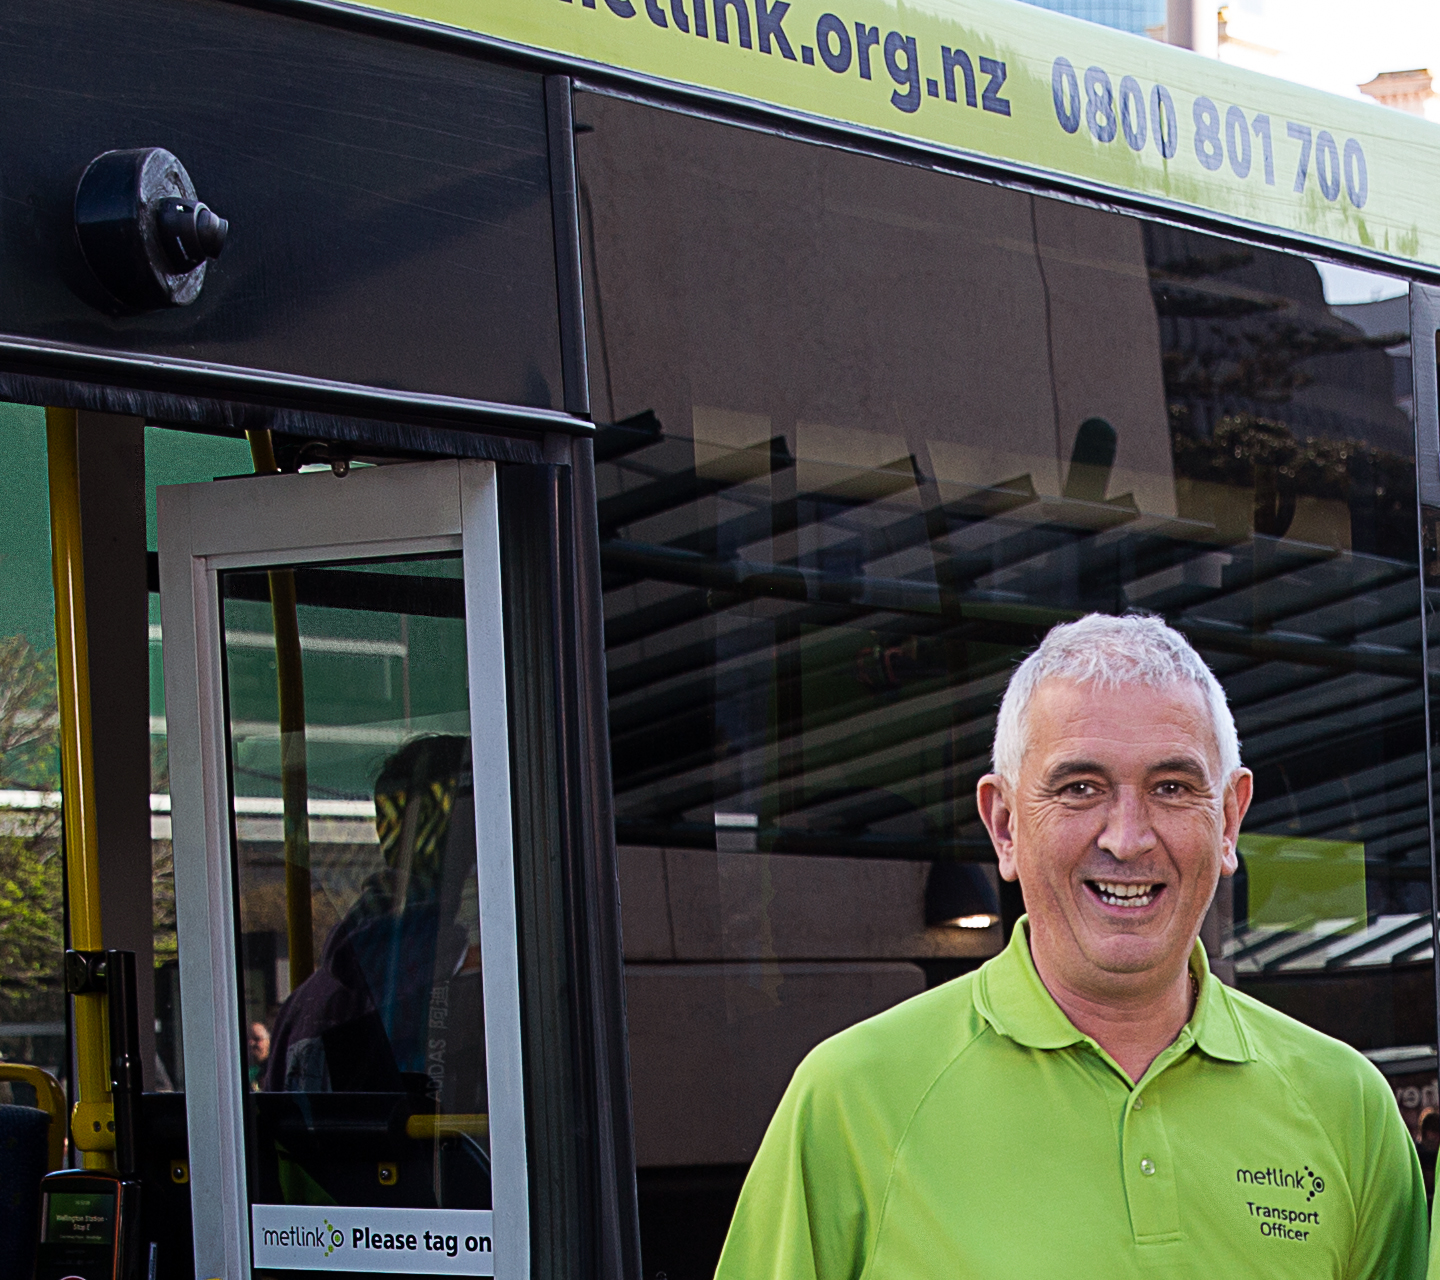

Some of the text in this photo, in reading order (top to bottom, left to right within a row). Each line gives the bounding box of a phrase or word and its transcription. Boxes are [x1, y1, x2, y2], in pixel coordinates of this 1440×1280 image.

[1051, 56, 1367, 209] 0800 801 700
[1237, 1167, 1305, 1190] metlink
[1246, 1202, 1320, 1225] Transport
[262, 1226, 493, 1258] metlink Please tag on
[1260, 1222, 1310, 1241] Officer
